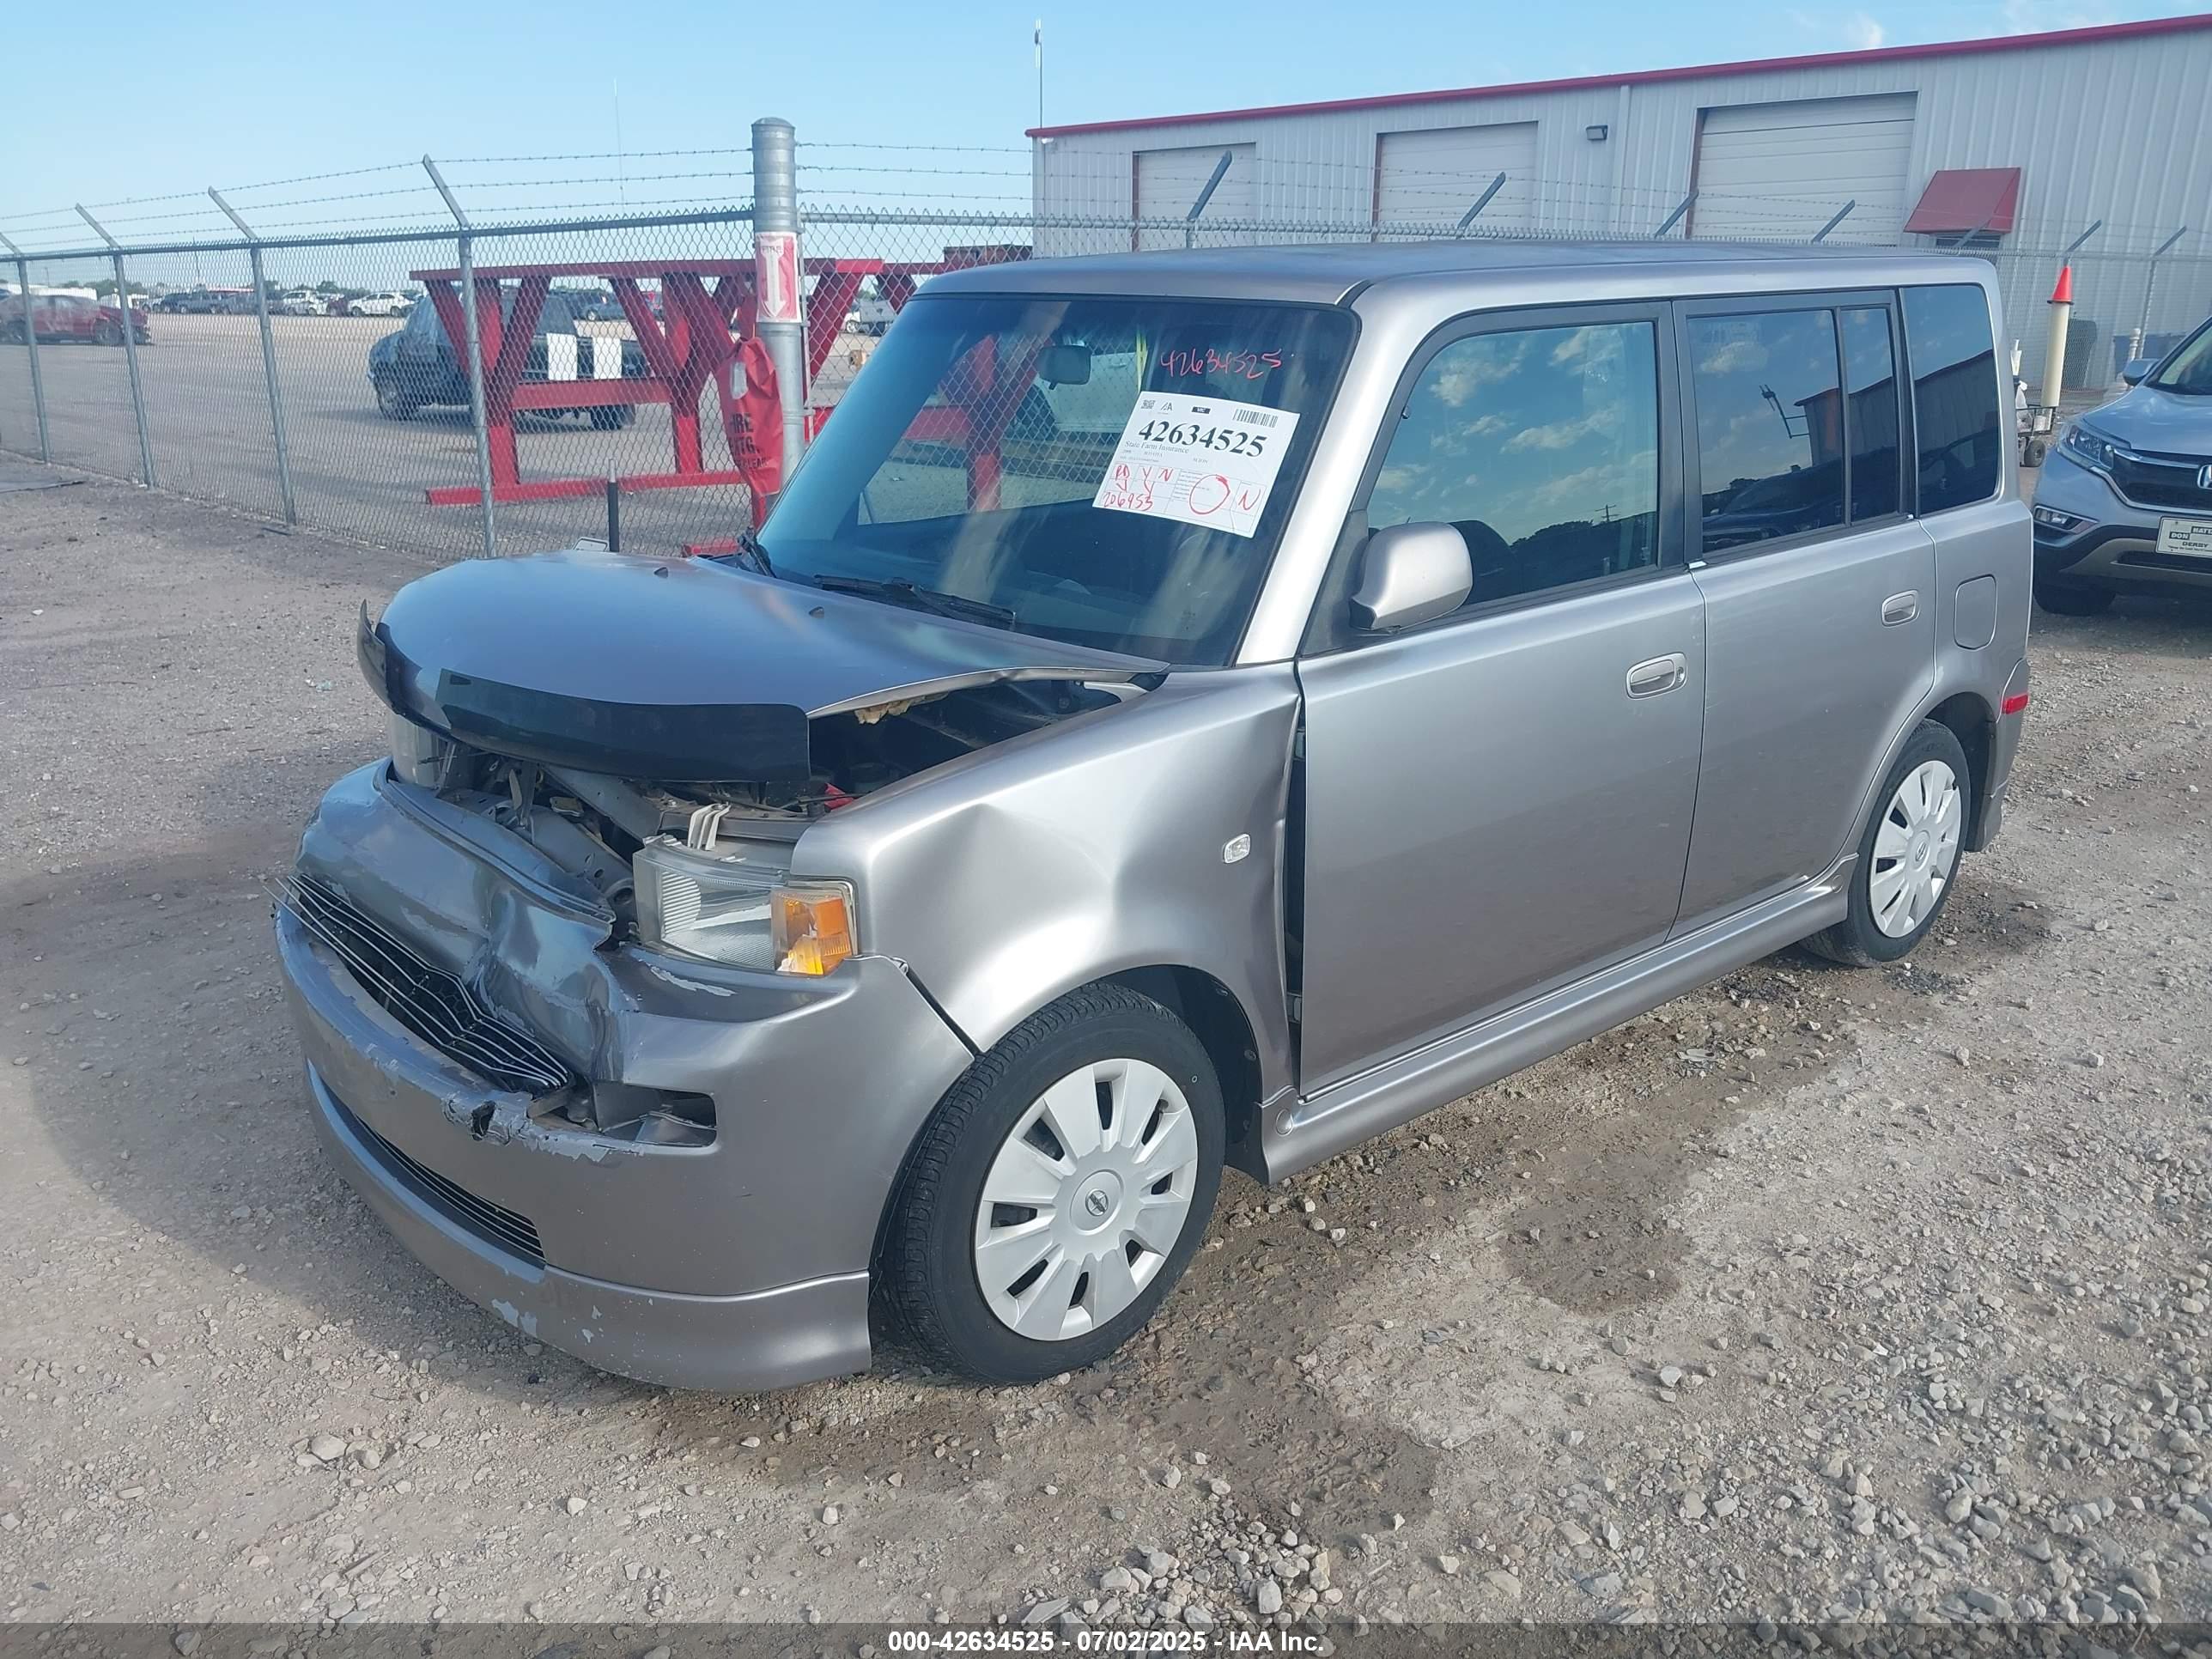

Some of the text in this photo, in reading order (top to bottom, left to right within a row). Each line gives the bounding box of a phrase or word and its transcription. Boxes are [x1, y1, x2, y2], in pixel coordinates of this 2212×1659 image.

[1160, 348, 1283, 380] 42634525
[1139, 419, 1267, 458] 42634525
[1158, 444, 1189, 454] Insurance
